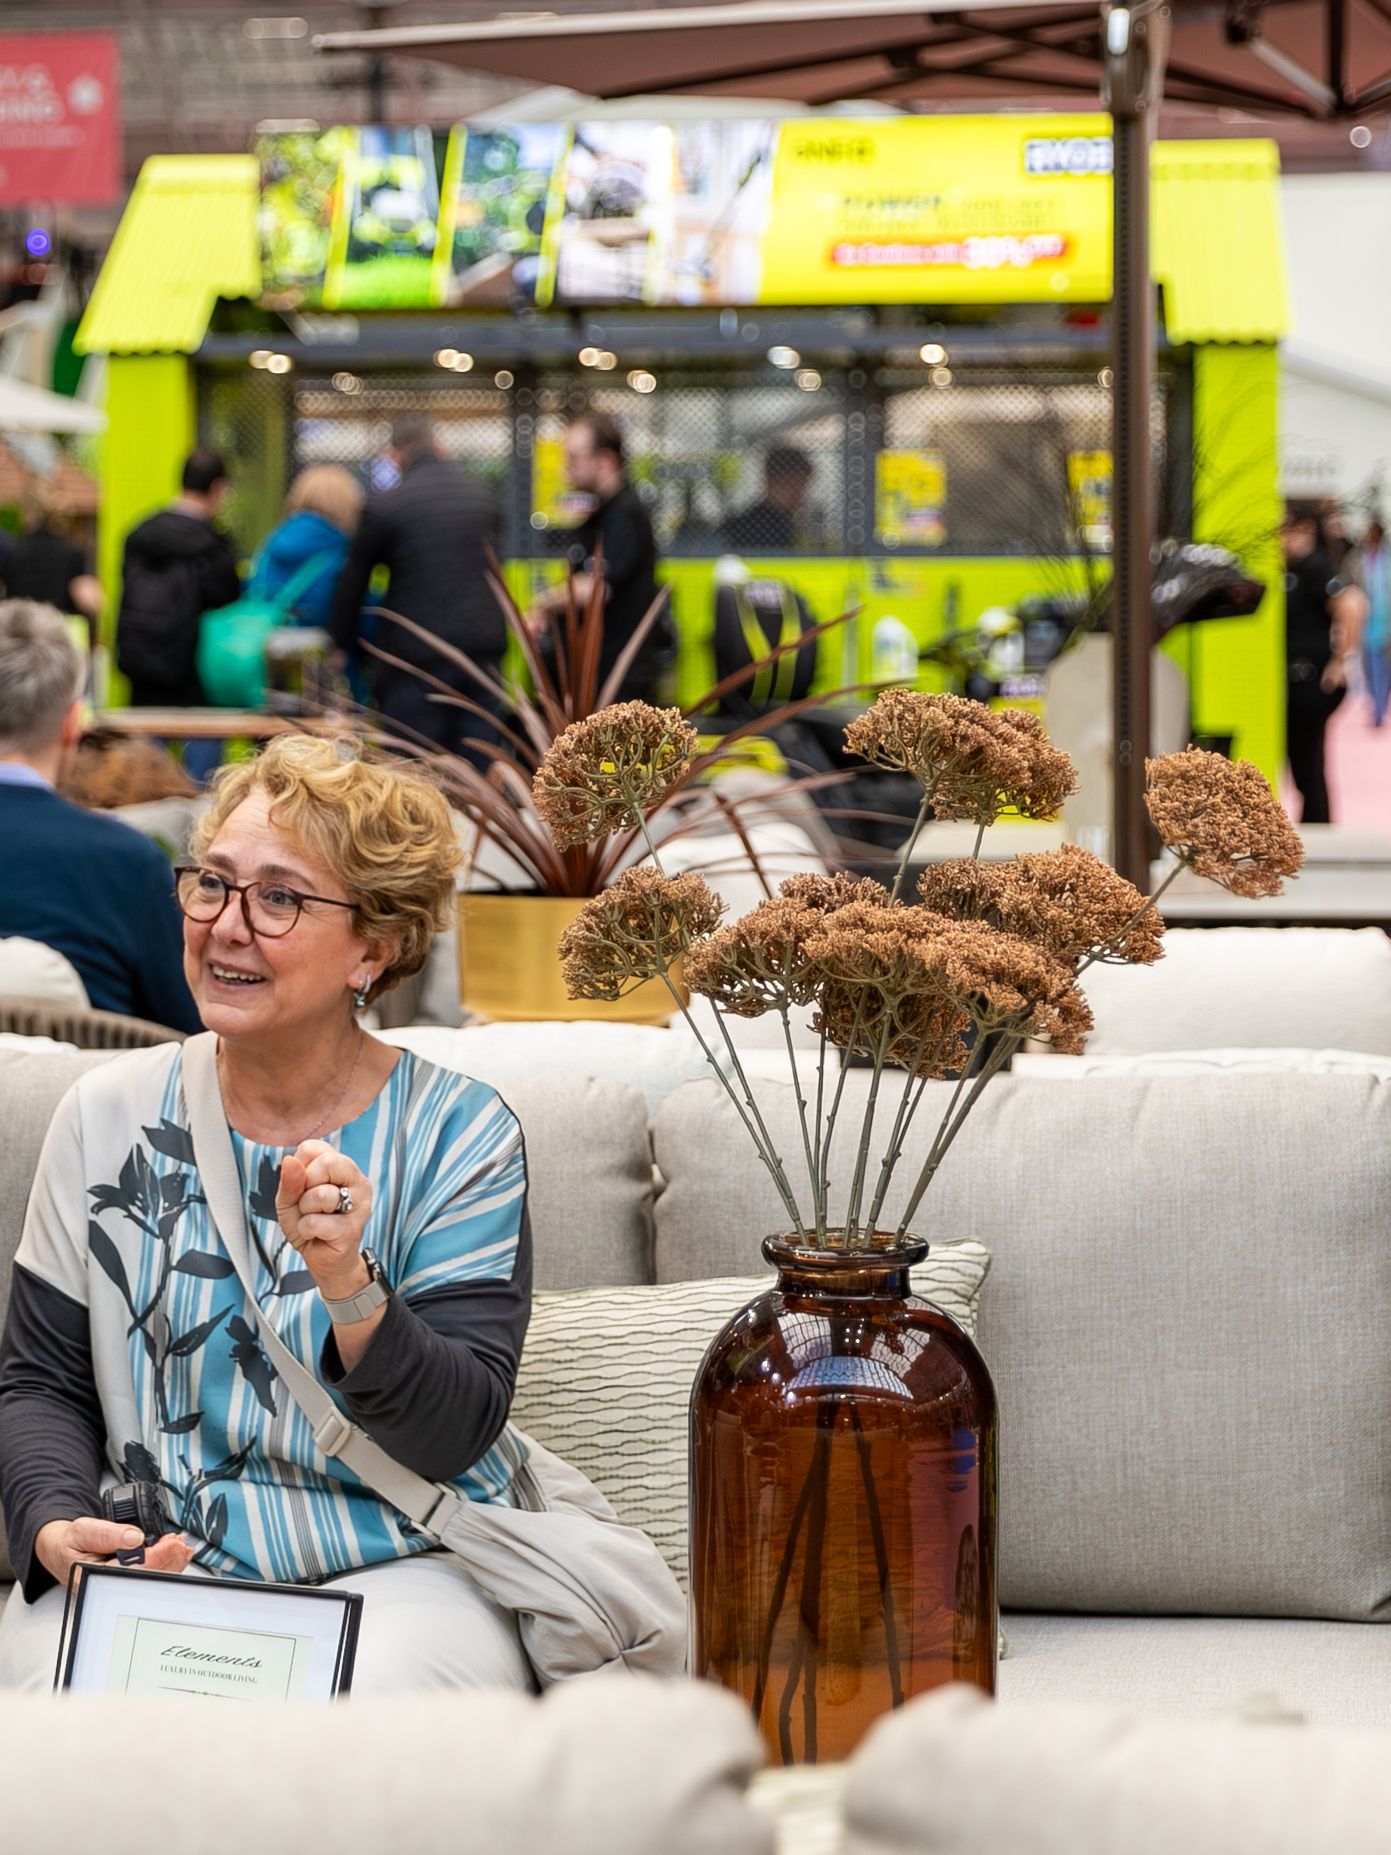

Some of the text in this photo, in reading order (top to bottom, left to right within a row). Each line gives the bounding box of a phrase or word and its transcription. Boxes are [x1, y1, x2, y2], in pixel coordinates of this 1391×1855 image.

[160, 1645, 263, 1668] Elements
[160, 1664, 188, 1675] LUXURY
[197, 1669, 234, 1681] OUTDOOR
[233, 1673, 258, 1684] LIVING
